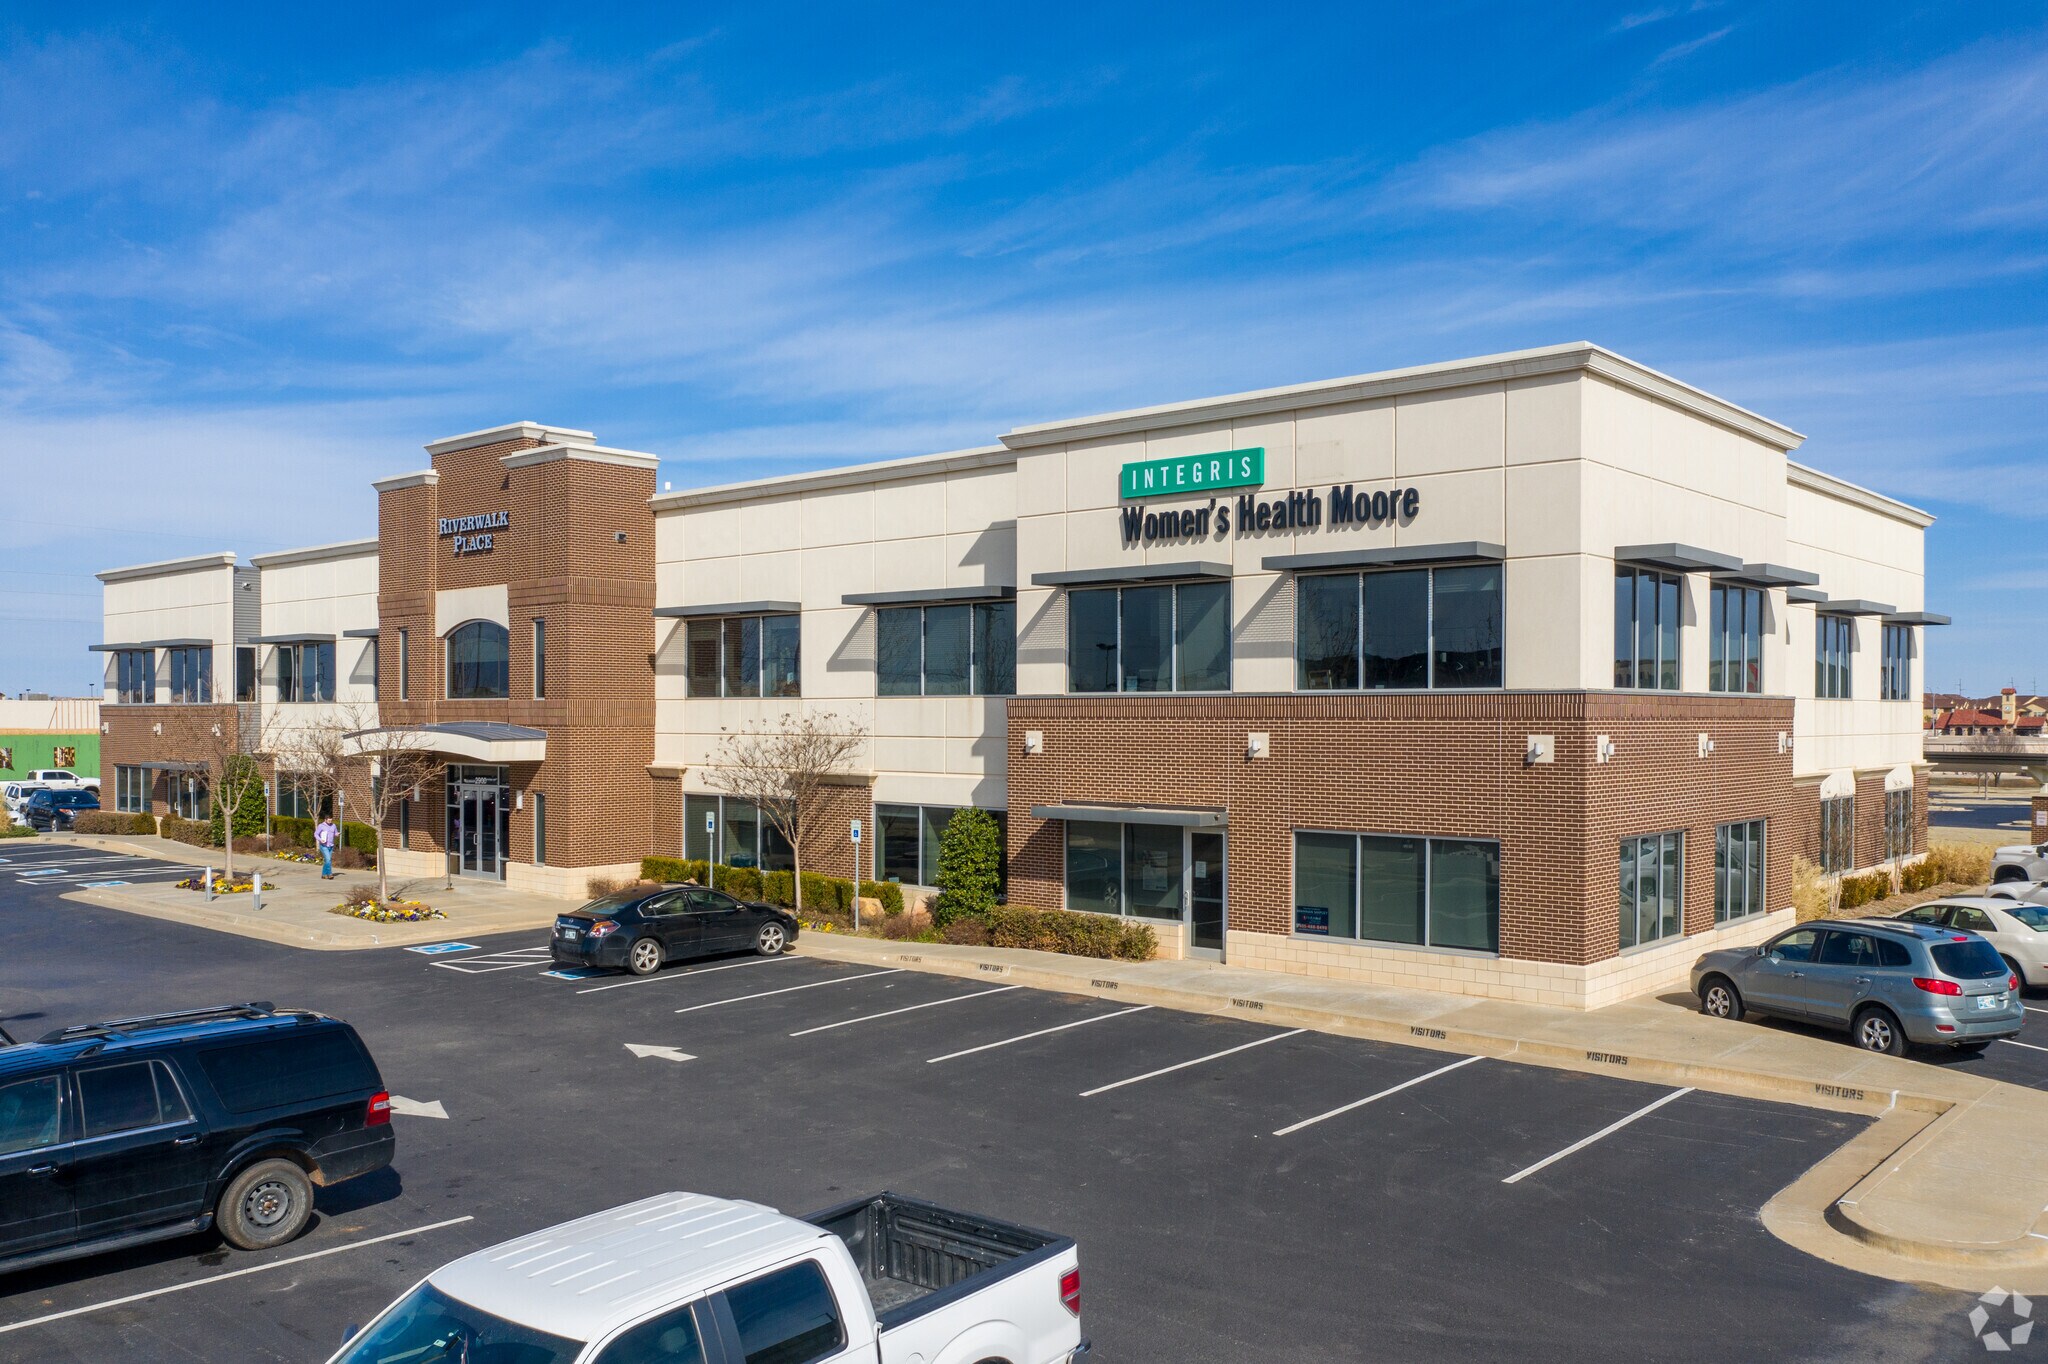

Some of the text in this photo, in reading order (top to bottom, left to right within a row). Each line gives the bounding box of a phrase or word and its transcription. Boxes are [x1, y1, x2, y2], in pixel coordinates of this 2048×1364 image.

[1132, 456, 1252, 490] INTEGRIS
[1122, 484, 1420, 542] Women's Health Moore
[439, 511, 509, 535] RIVERWALK
[453, 534, 493, 553] PLACE
[979, 963, 1004, 973] VISITORS
[1091, 979, 1119, 990] VISITORS
[1232, 998, 1263, 1010] VISITORS
[1410, 1026, 1446, 1040] VISITORS
[1586, 1051, 1628, 1065] VISITORS
[1815, 1084, 1864, 1101] VISITORS
